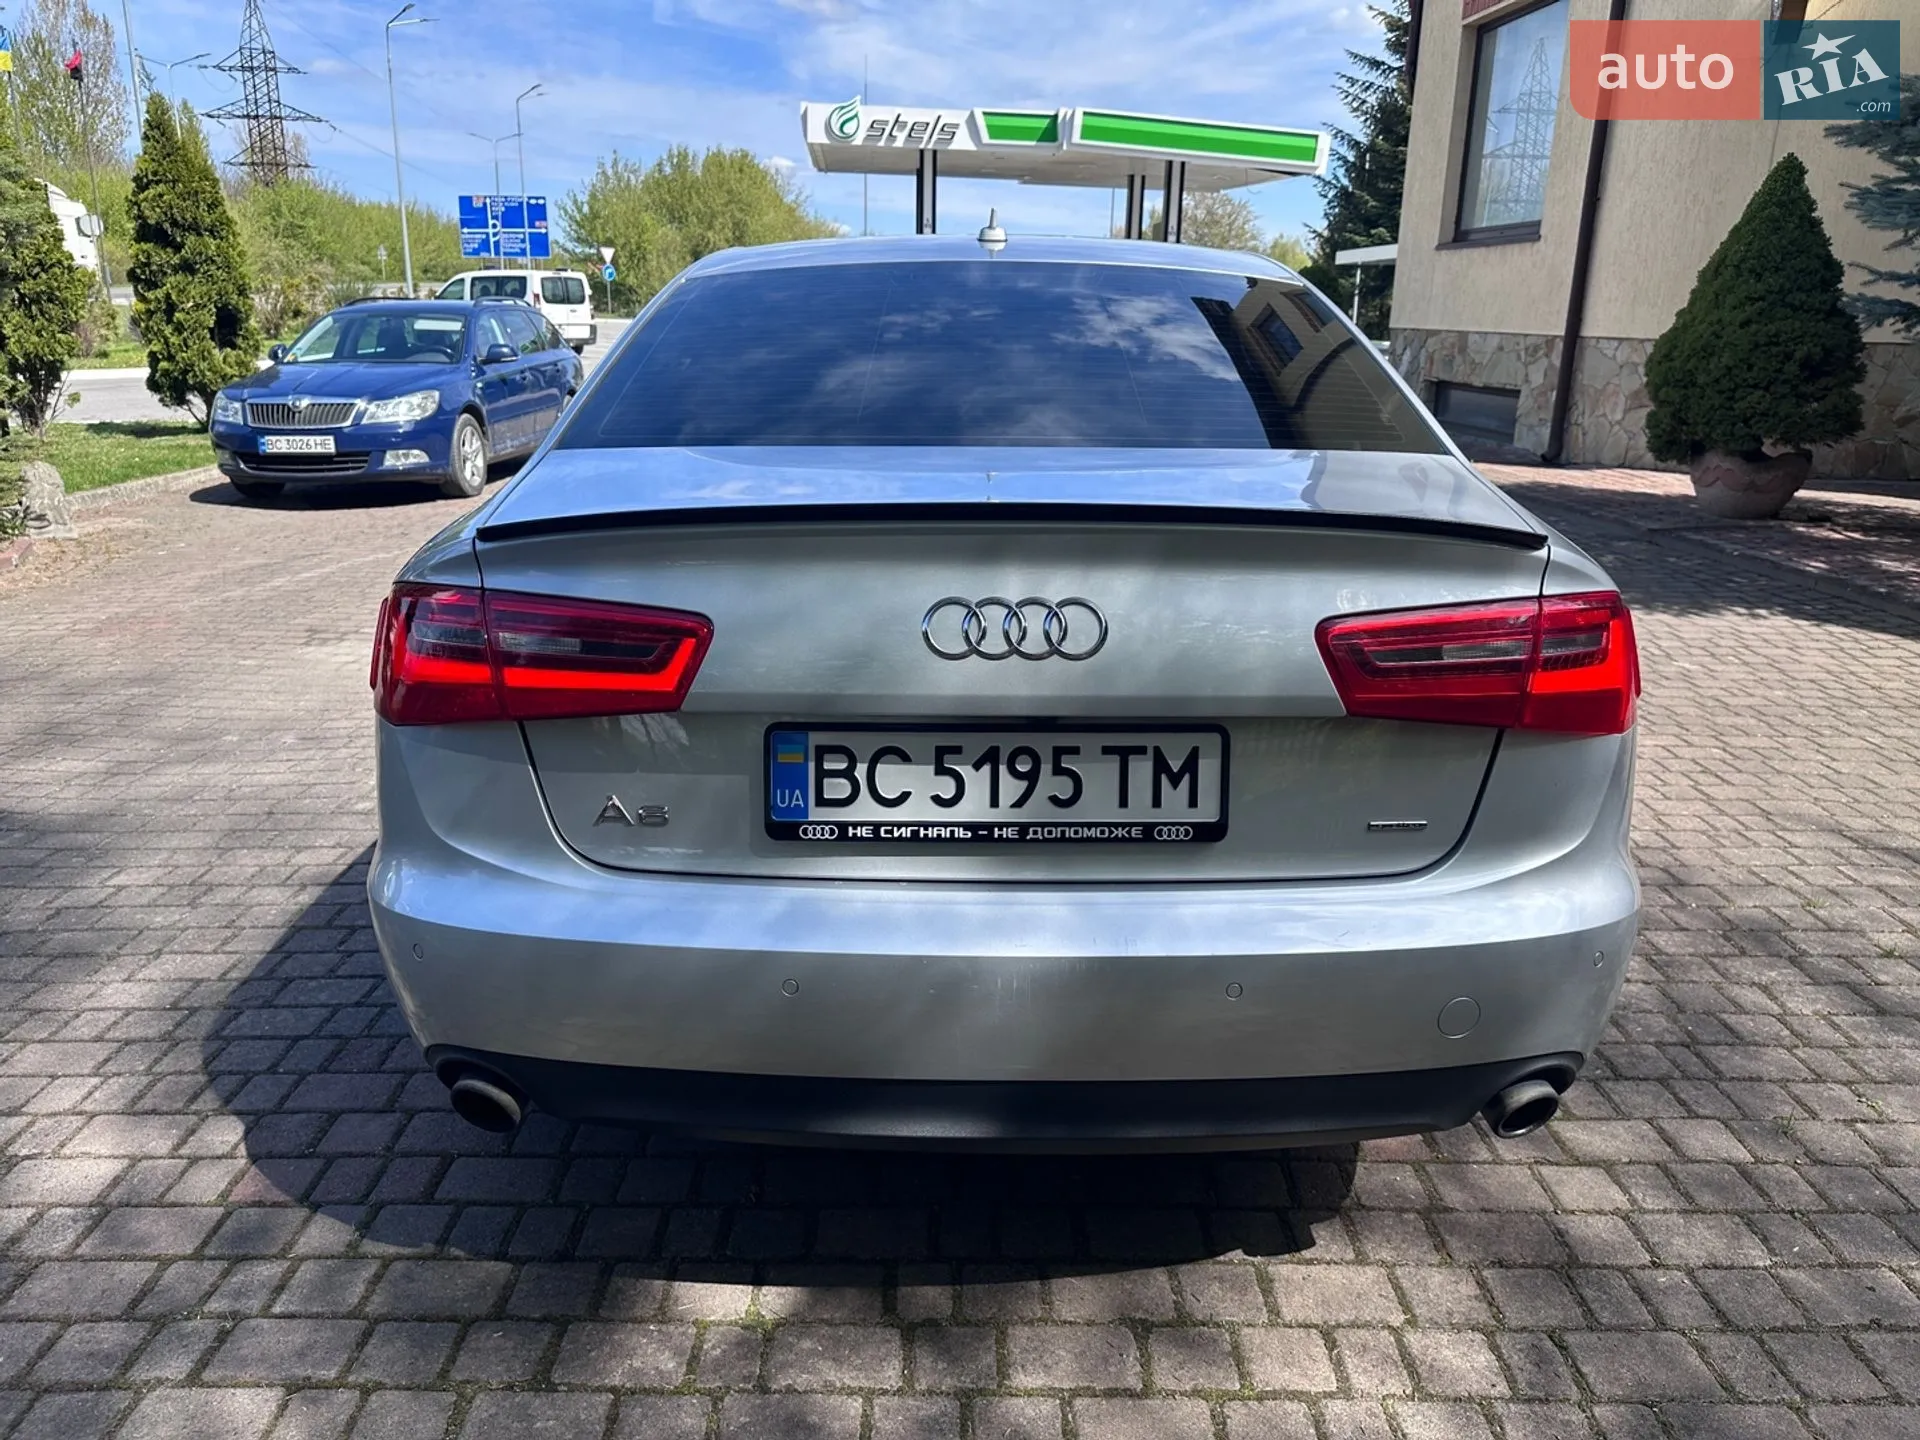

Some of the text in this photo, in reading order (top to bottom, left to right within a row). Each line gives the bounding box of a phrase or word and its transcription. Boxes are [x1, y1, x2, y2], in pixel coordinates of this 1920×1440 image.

[866, 113, 960, 140] stels
[285, 438, 312, 450] 3026
[814, 744, 1200, 809] BC 5195 TM
[776, 789, 804, 808] UA
[592, 795, 669, 827] A6
[848, 826, 874, 838] НЕ
[994, 827, 1020, 839] НЕ
[1026, 827, 1143, 840] ДОПОМОЖЕ
